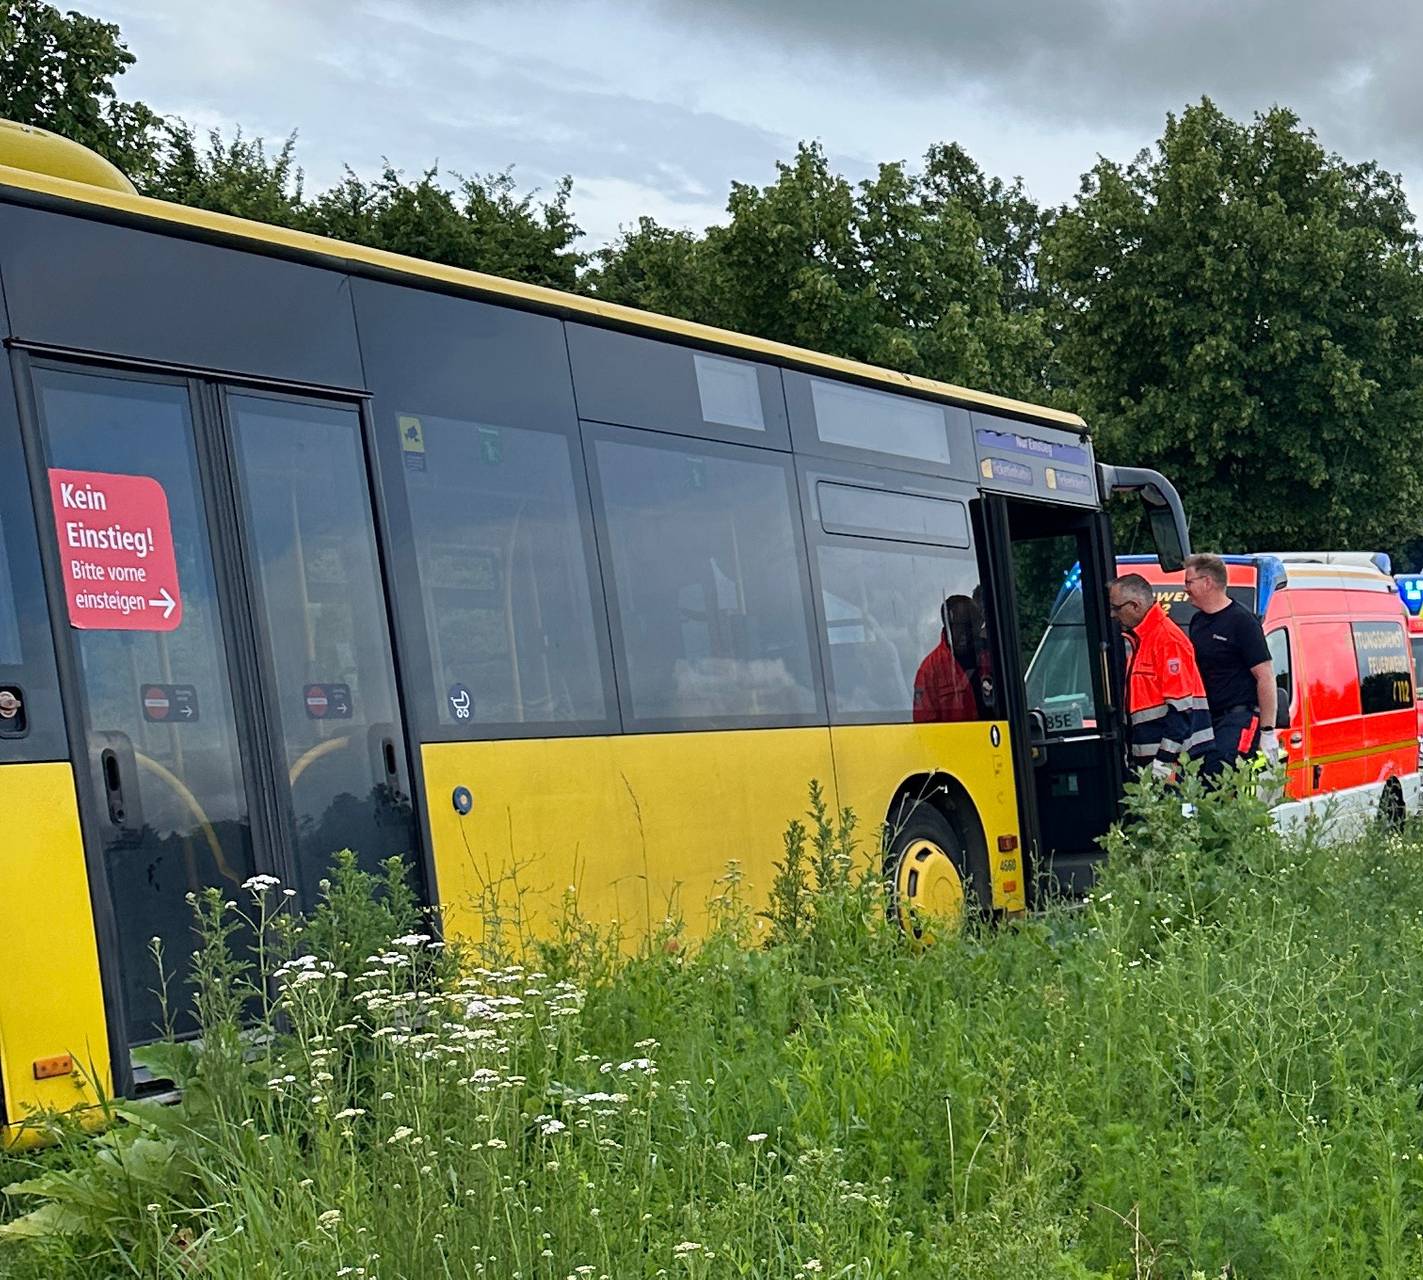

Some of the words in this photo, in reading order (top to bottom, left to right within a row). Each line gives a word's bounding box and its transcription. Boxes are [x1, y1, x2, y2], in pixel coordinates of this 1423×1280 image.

[60, 483, 106, 510] Kein
[66, 522, 154, 557] Einstieg!
[71, 560, 105, 581] Bitte
[108, 567, 147, 582] vorne
[75, 589, 146, 615] einsteigen
